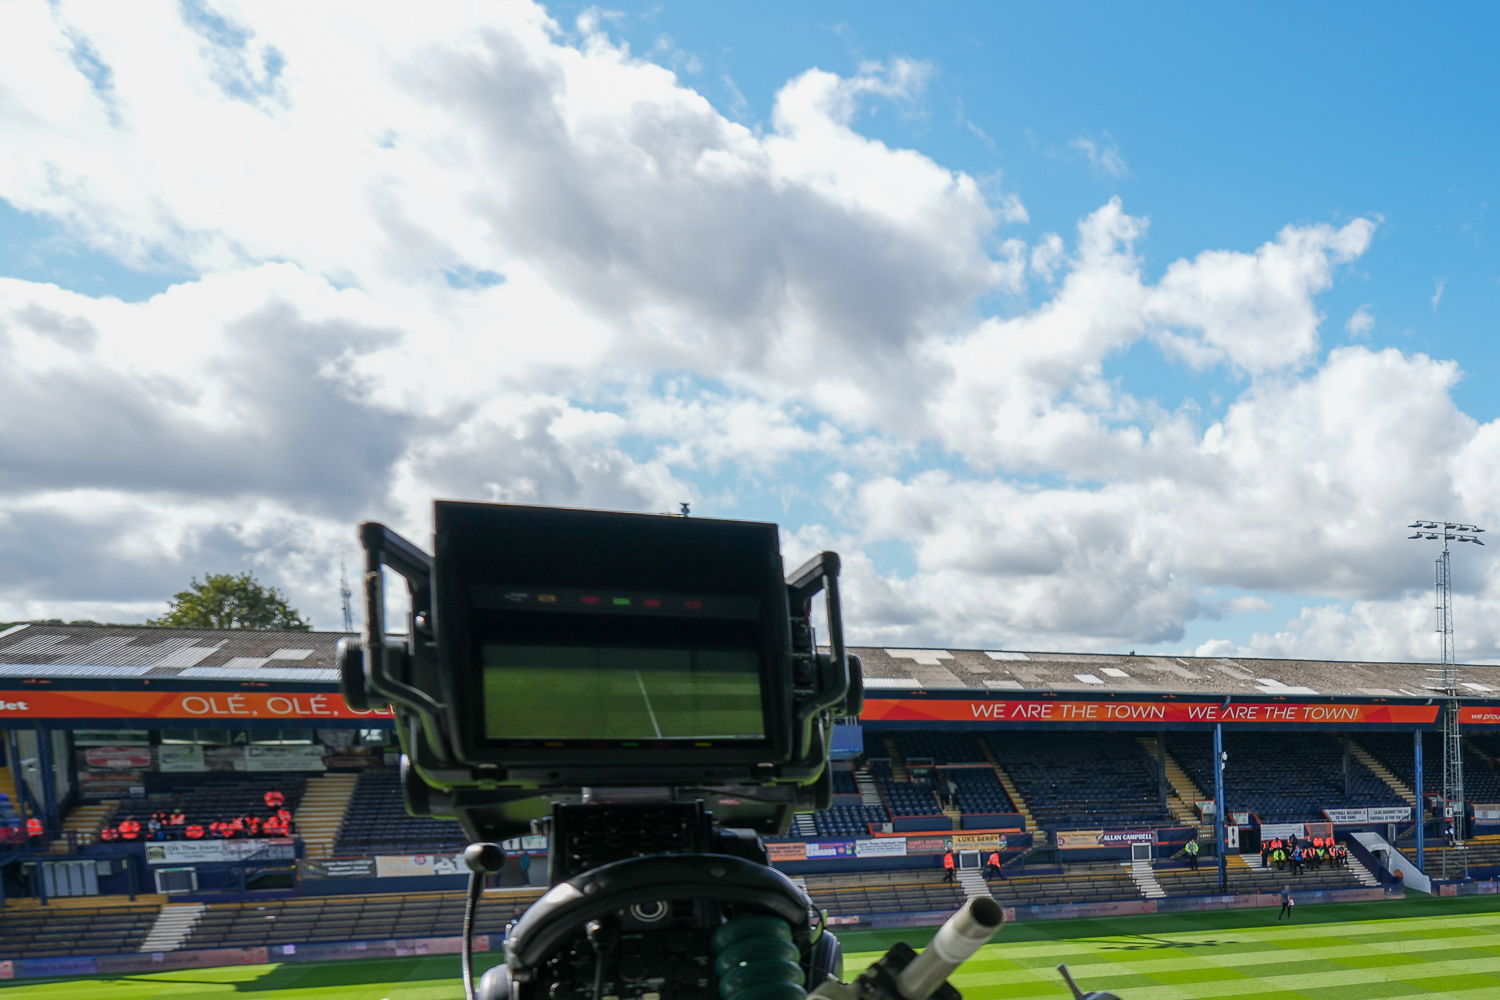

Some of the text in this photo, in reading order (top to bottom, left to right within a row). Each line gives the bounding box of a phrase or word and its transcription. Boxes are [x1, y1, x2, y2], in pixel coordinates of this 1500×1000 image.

[182, 694, 258, 716] OLÉ,
[266, 694, 339, 717] OLÉ,
[971, 704, 1165, 719] WE ARE THE TOWN
[1188, 706, 1360, 720] WE ARE THE TOWN!
